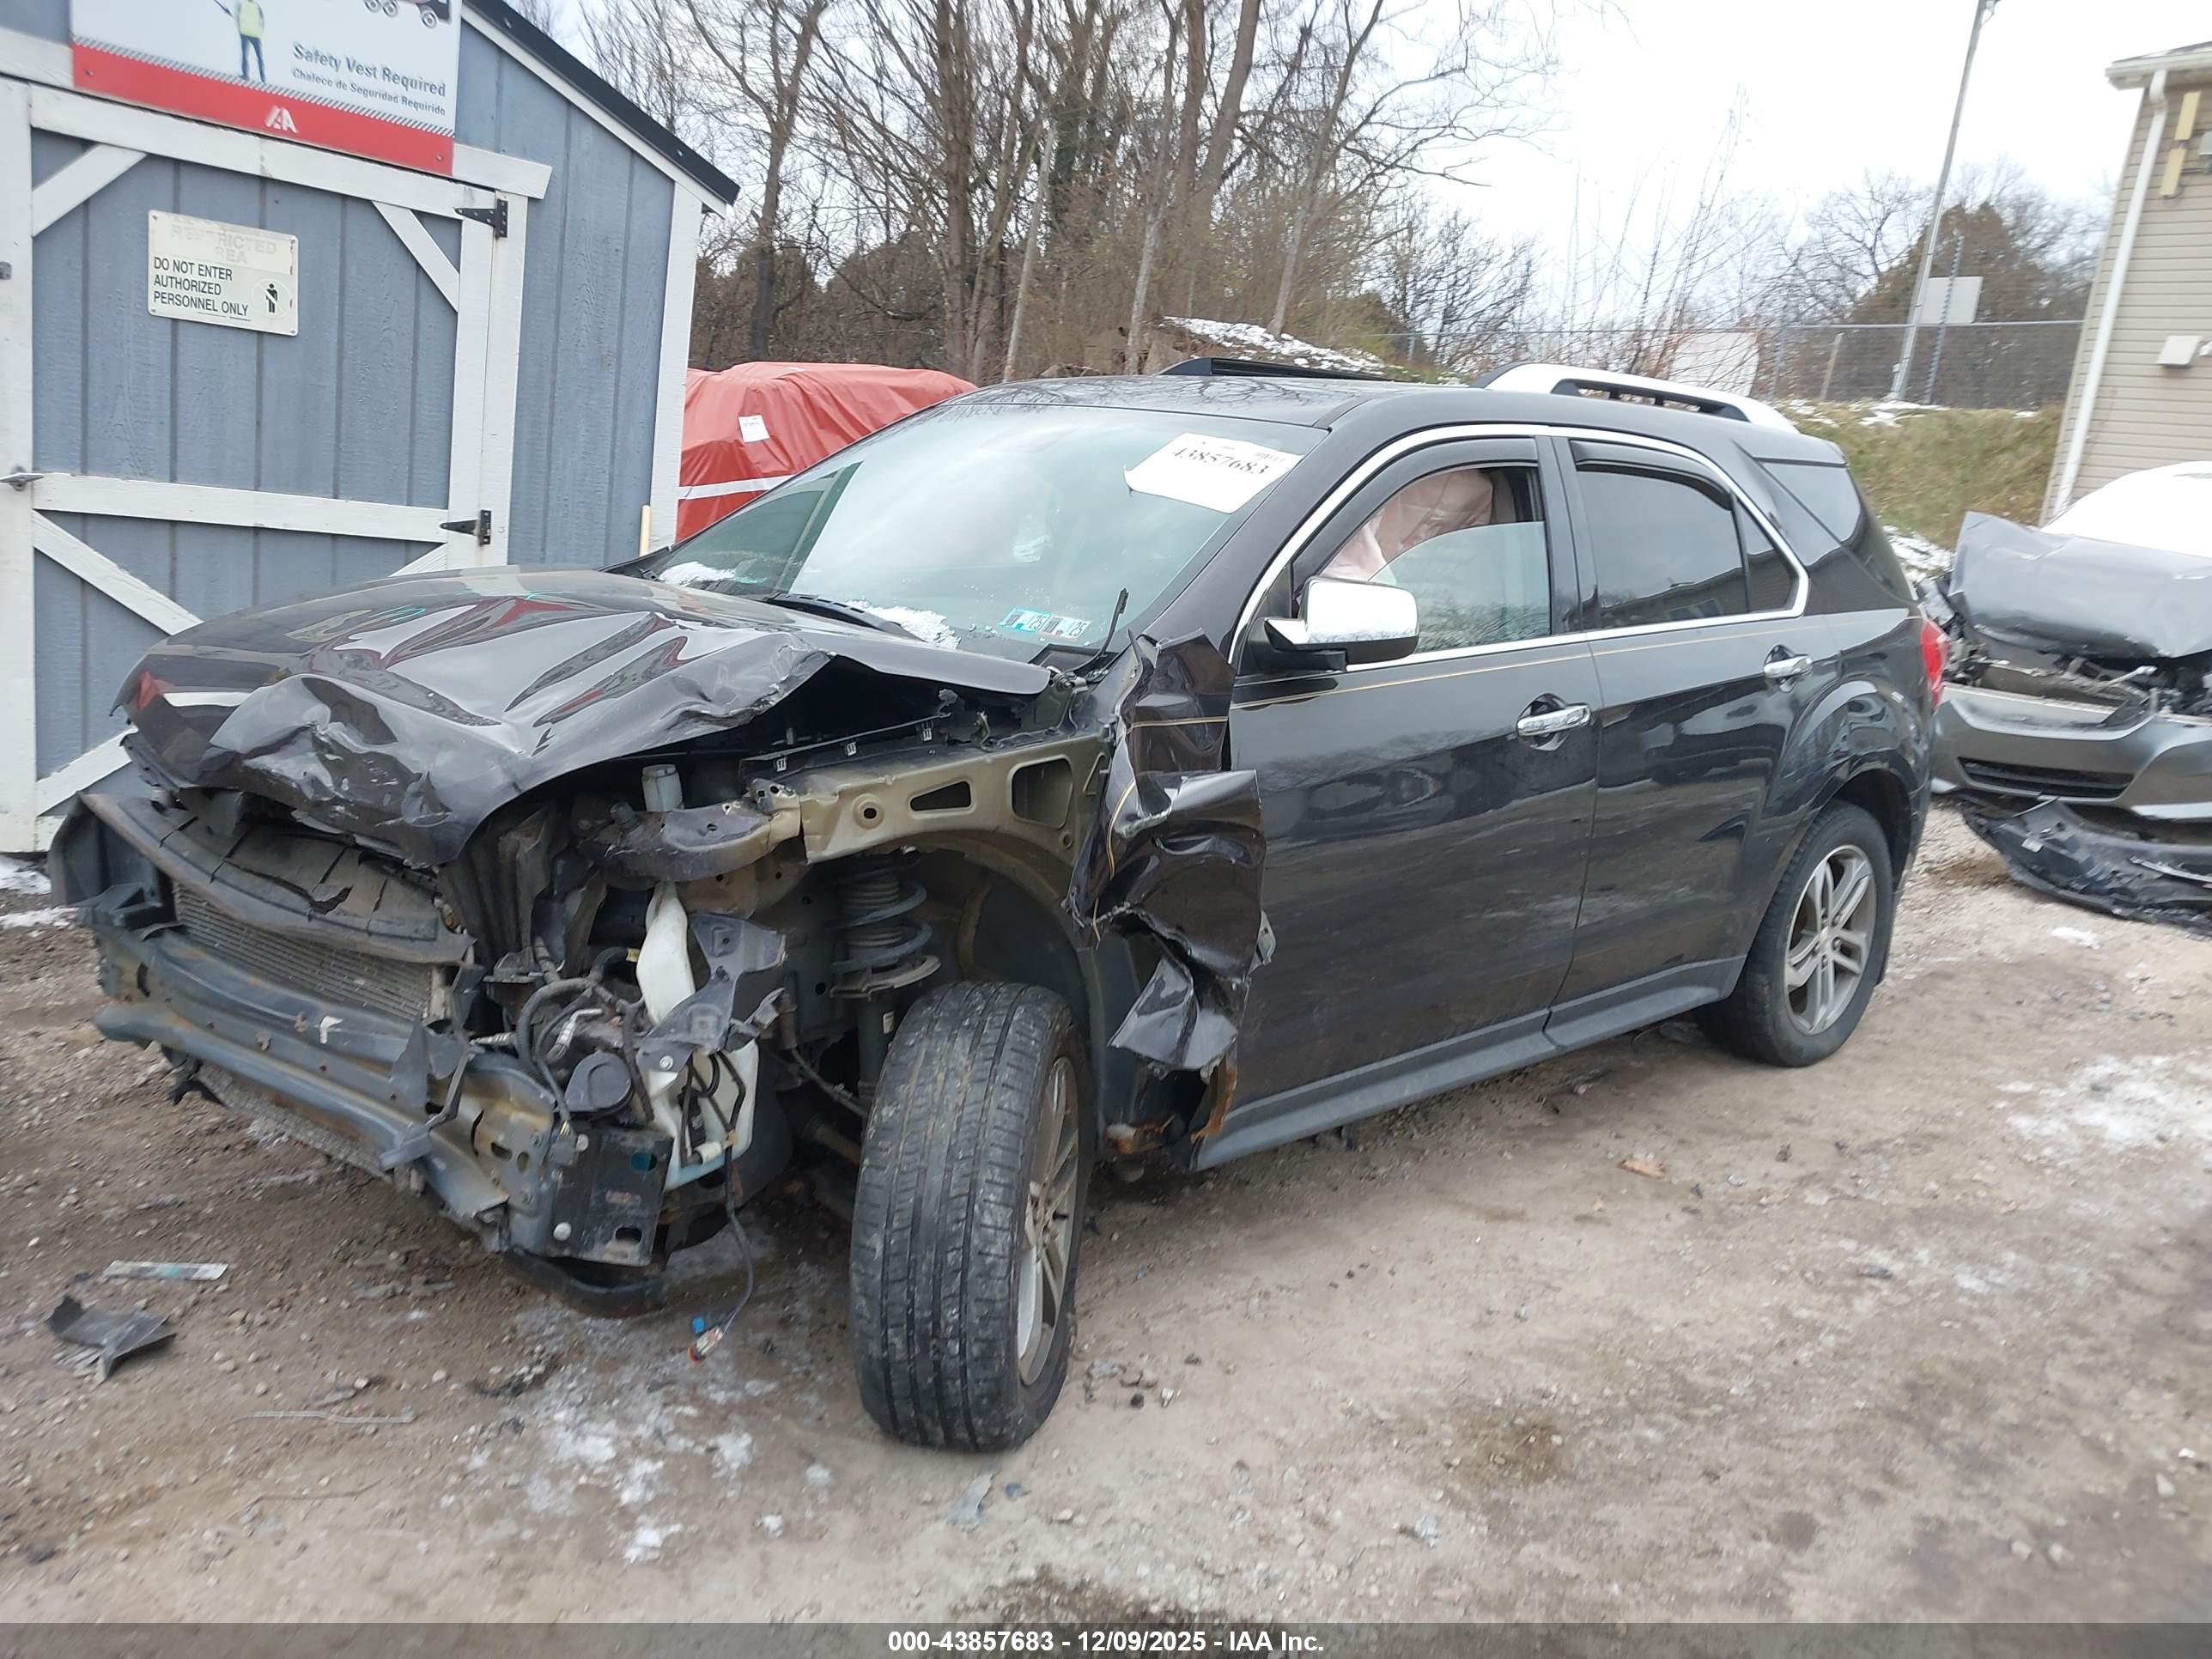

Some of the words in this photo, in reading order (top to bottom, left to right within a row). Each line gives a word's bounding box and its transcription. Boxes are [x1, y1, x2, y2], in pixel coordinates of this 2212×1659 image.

[293, 43, 342, 72] Safety
[345, 57, 378, 80] Vest
[382, 65, 446, 97] Required
[293, 68, 333, 88] Chaleco
[336, 81, 348, 91] de
[349, 82, 398, 104] Seguridad
[401, 95, 446, 116] Requirido
[154, 257, 170, 270] DO
[173, 259, 195, 275] NOT
[198, 264, 233, 281] ENTER
[154, 274, 222, 296] AUTHORIZED
[154, 290, 218, 312] PERSONNEL
[221, 301, 249, 316] ONLY
[1171, 447, 1270, 474] 43857683
